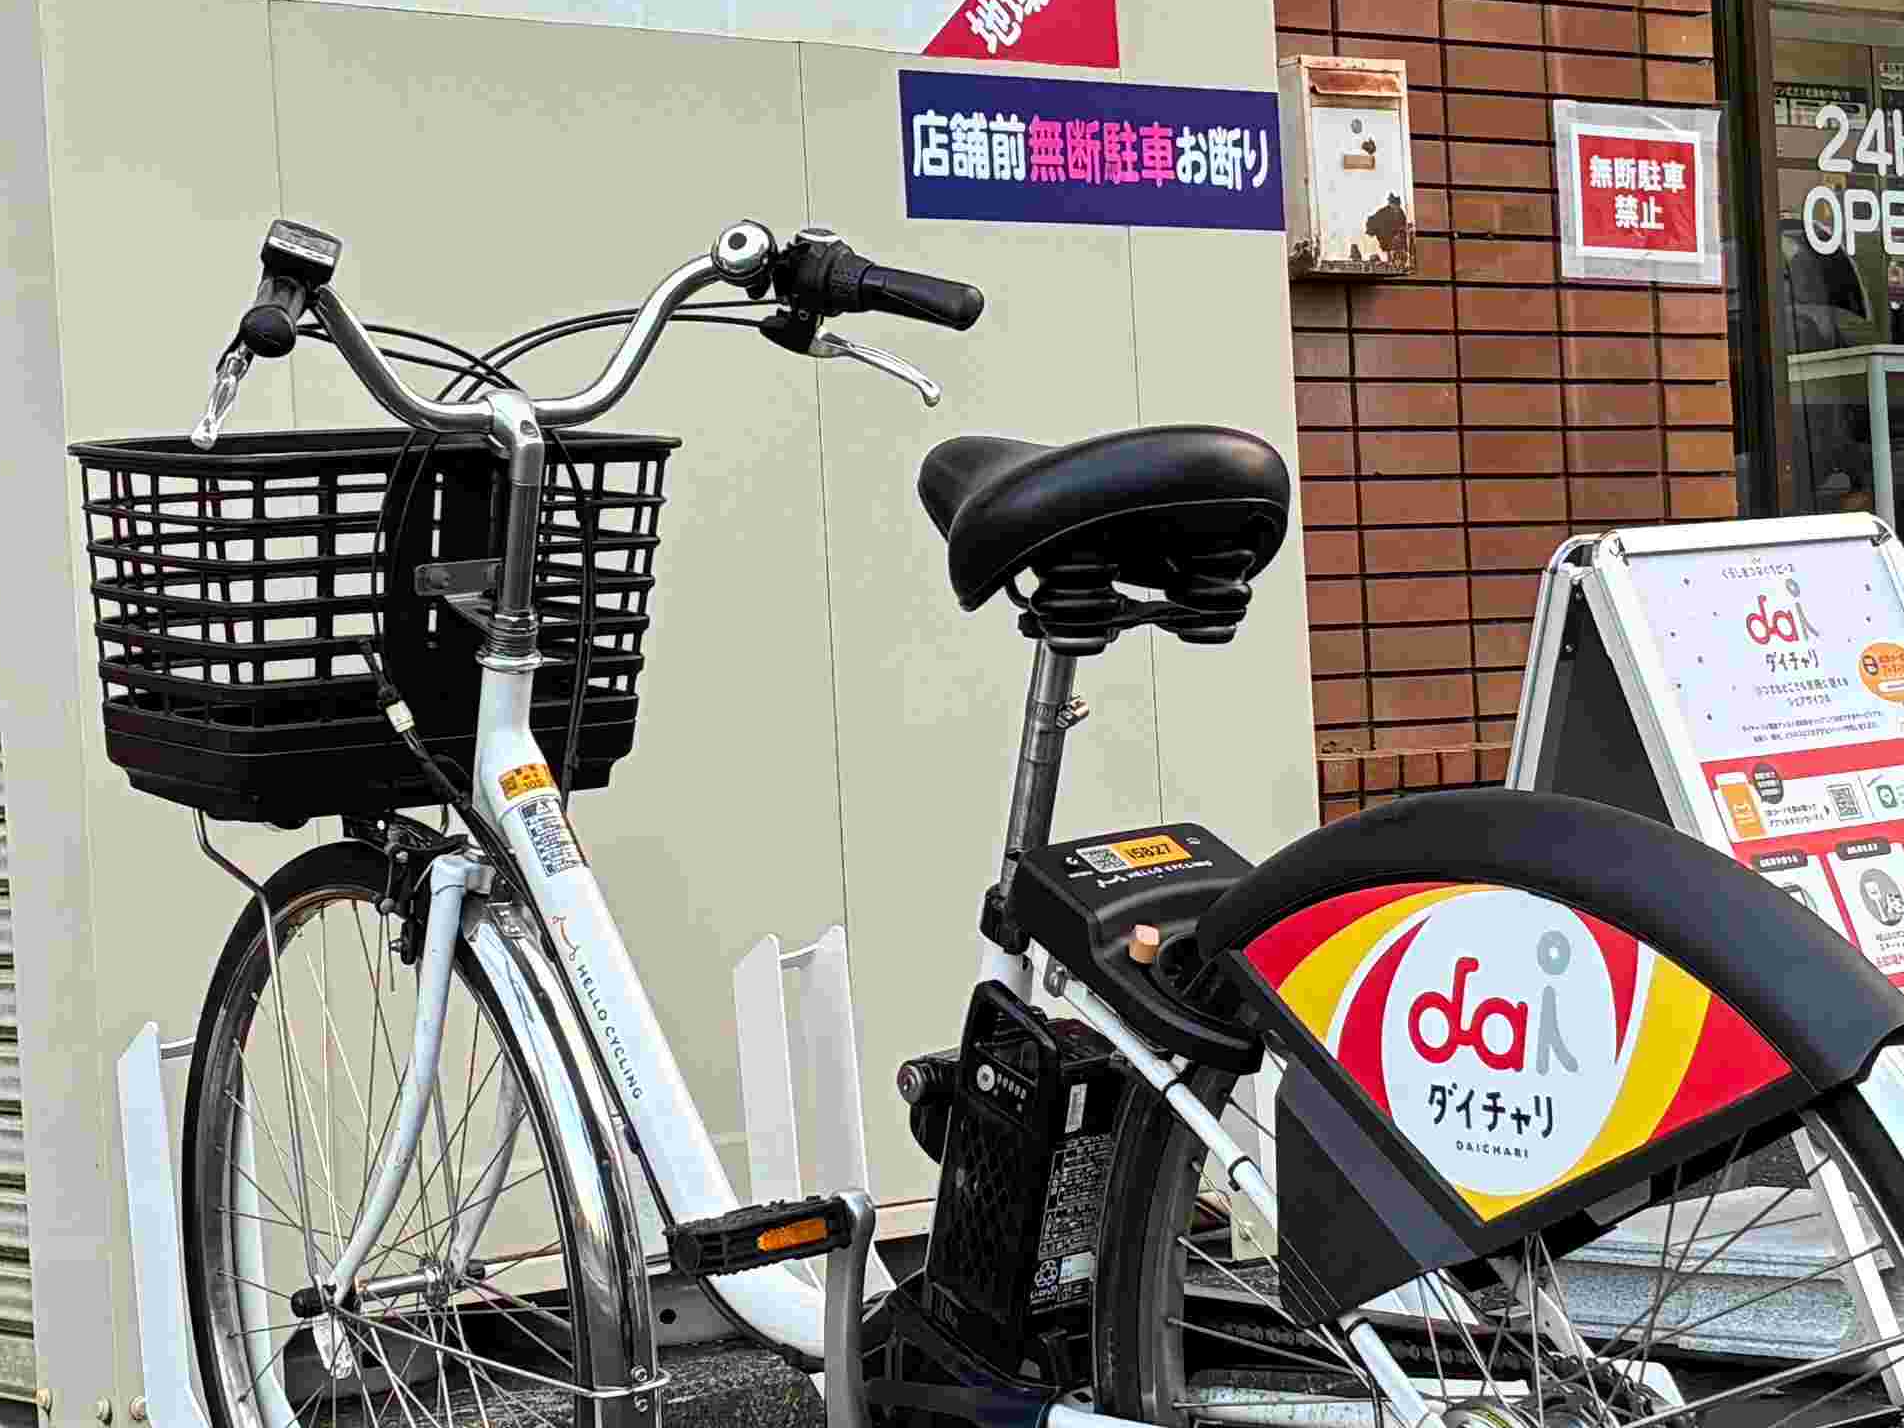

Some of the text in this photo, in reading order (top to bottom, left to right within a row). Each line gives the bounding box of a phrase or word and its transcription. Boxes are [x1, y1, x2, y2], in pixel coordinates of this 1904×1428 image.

[912, 109, 1270, 195] 店舗前無断駐車お断り
[1588, 152, 1686, 196] 無断駐車
[1614, 194, 1665, 234] 禁止
[577, 963, 644, 1101] HELLO CYCLING
[1427, 1083, 1554, 1139] ダイチャリ
